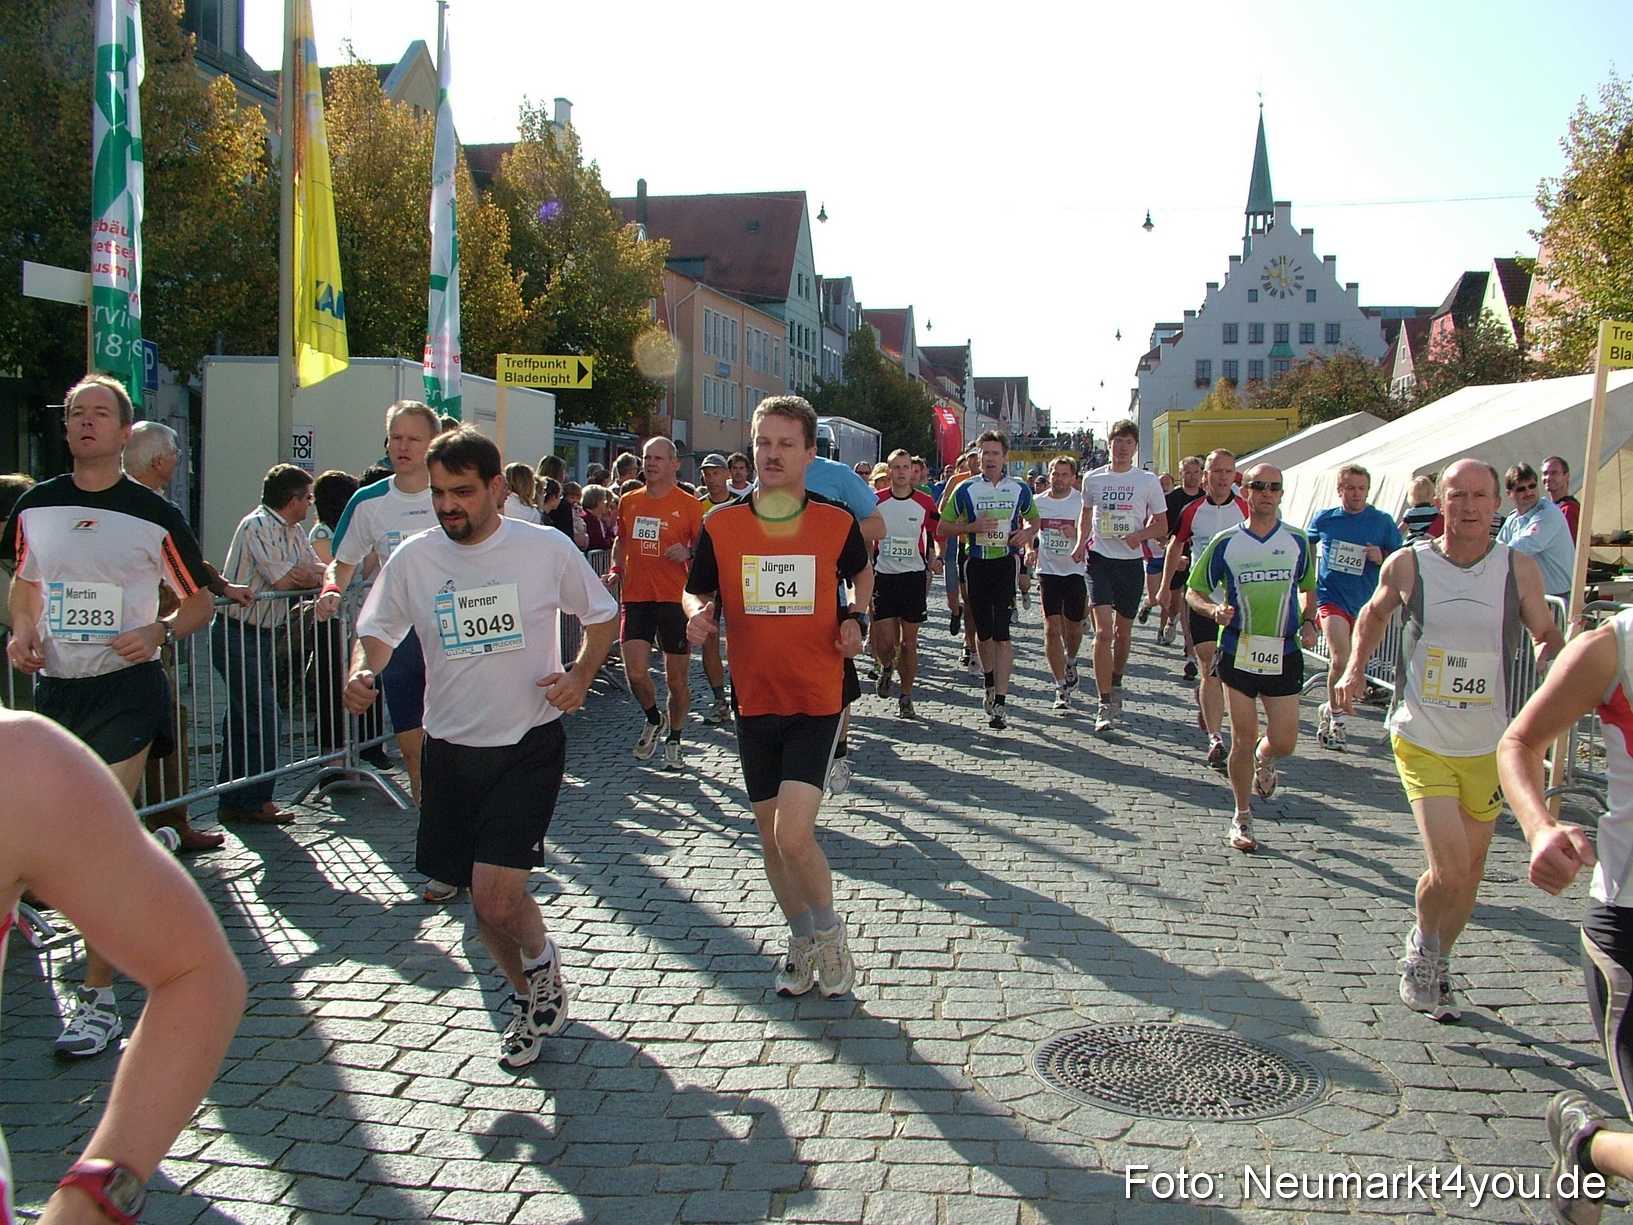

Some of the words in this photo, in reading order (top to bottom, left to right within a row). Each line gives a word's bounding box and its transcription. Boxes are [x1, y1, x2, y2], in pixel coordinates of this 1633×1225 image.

[144, 347, 154, 383] P
[504, 357, 567, 371] Treffpunkt
[504, 371, 571, 386] Bladenight
[292, 434, 312, 447] TOI
[292, 446, 312, 459] TOI
[1101, 491, 1134, 501] 2007
[976, 501, 1015, 511] BOCK
[638, 528, 657, 539] 863
[1113, 523, 1130, 532] 898
[987, 531, 1004, 540] 660
[643, 541, 658, 551] GfK
[1050, 539, 1069, 548] 2307
[892, 547, 913, 556] 2338
[1337, 554, 1363, 567] 2426
[761, 560, 796, 575] Jürgen
[1238, 568, 1291, 584] BOCK
[66, 587, 97, 600] Martin
[774, 581, 799, 598] 64
[458, 595, 498, 610] Werner
[66, 608, 115, 627] 2383
[462, 613, 515, 638] 3049
[1250, 650, 1280, 665] 1046
[1447, 655, 1468, 668] Willi
[1452, 677, 1487, 694] 548
